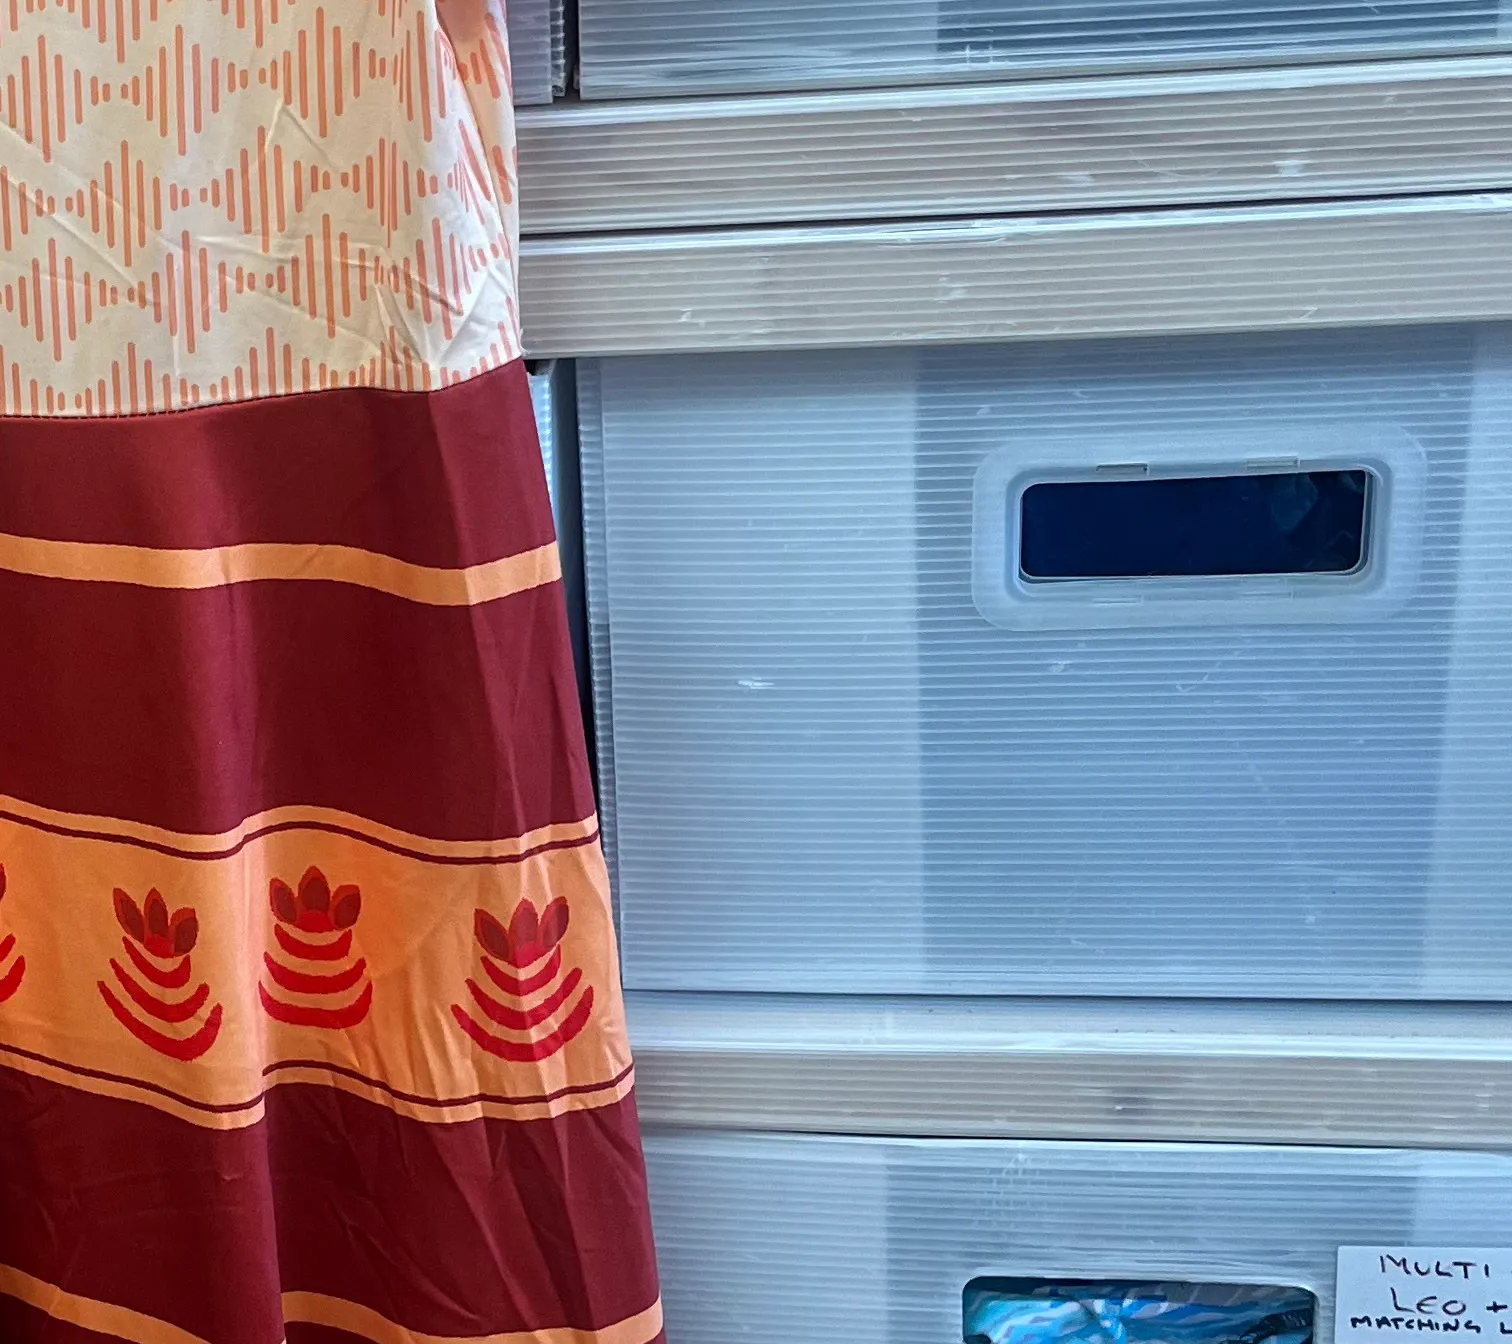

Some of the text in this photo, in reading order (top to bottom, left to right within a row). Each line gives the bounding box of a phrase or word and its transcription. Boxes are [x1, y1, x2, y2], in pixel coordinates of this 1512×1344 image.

[1379, 1253, 1491, 1280] MULTI
[1389, 1286, 1467, 1316] LEO
[1350, 1315, 1482, 1335] MATCHING
